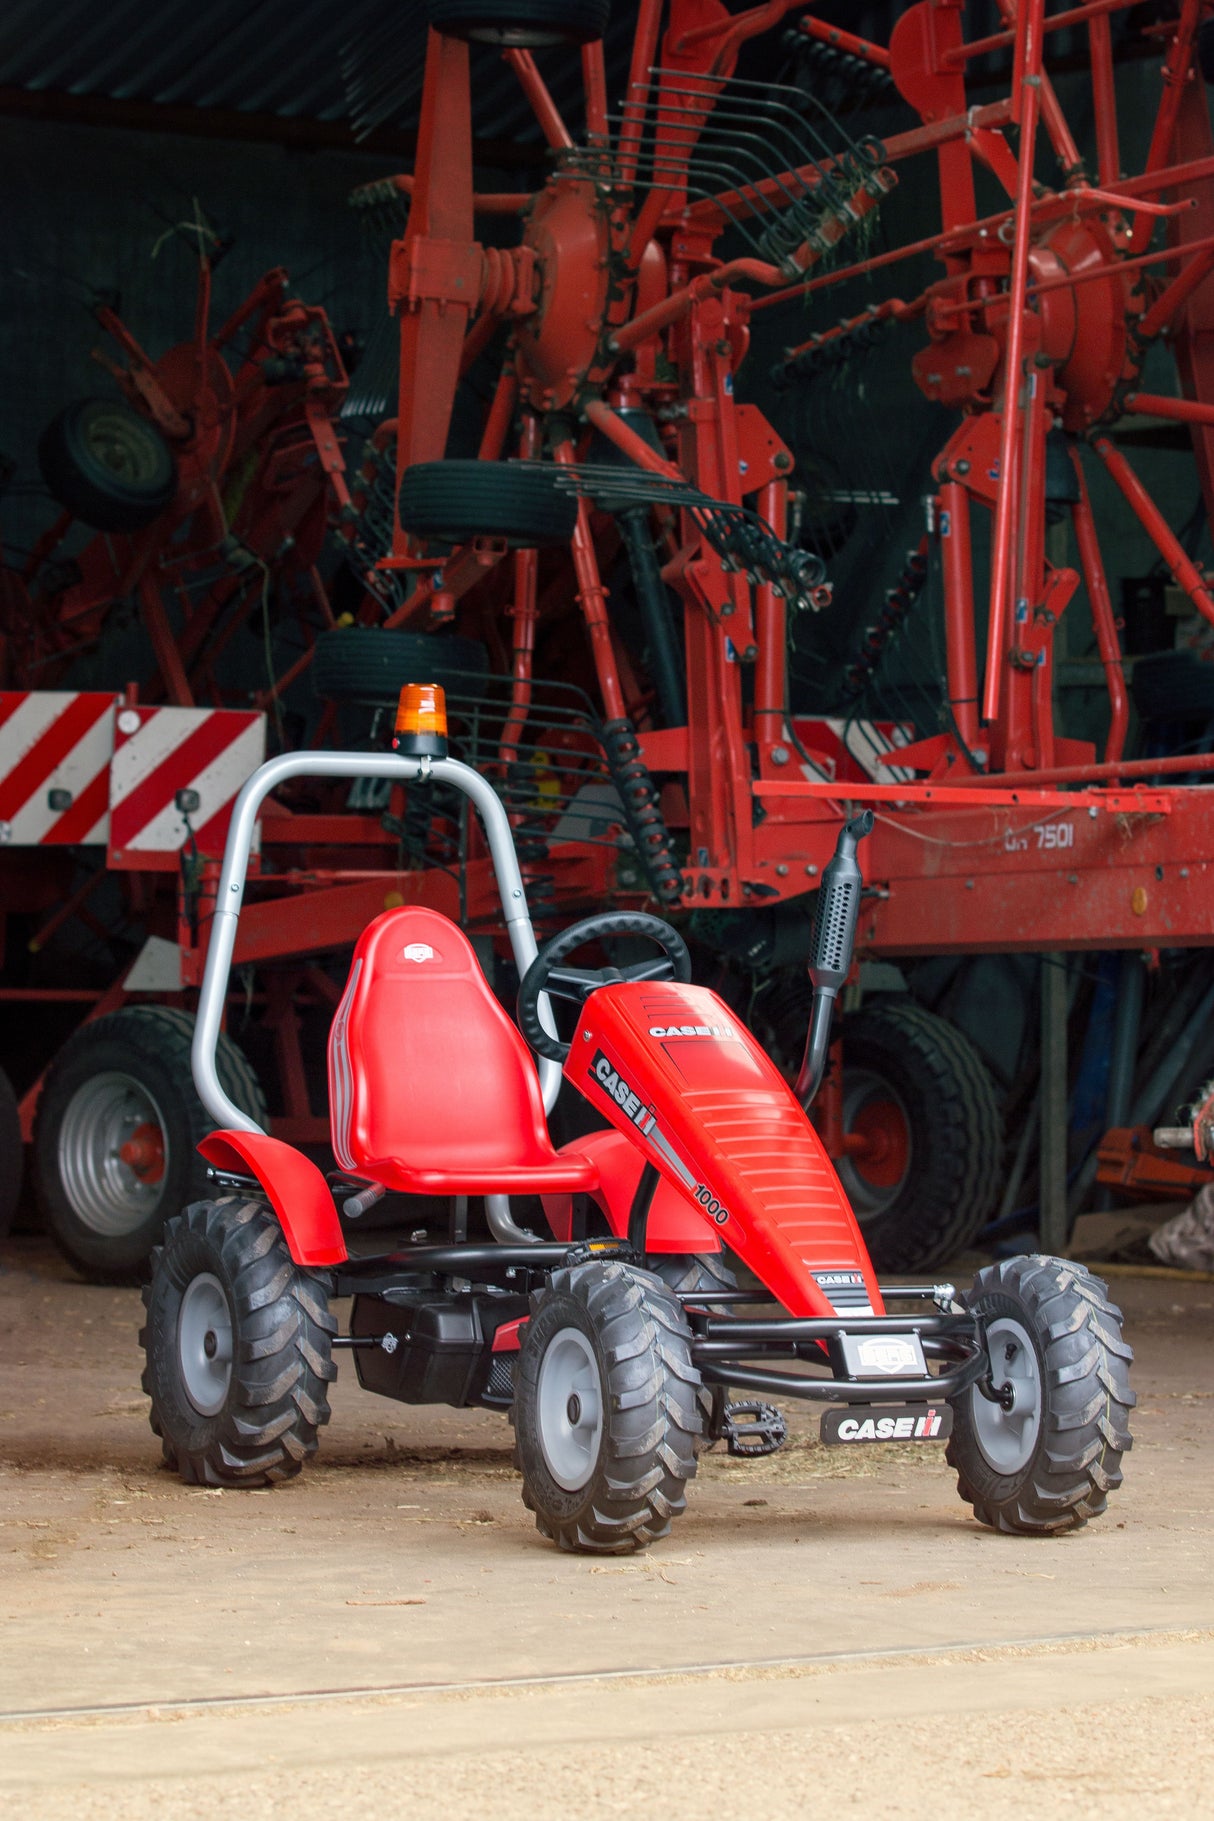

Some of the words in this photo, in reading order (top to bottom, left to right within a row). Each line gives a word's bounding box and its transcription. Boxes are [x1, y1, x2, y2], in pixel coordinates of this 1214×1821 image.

[1033, 823, 1074, 849] 7501
[648, 1026, 712, 1038] CASE
[596, 1058, 641, 1118] CASE
[695, 1184, 728, 1224] 1000
[816, 1275, 850, 1285] CASE
[838, 1417, 915, 1441] CASE
